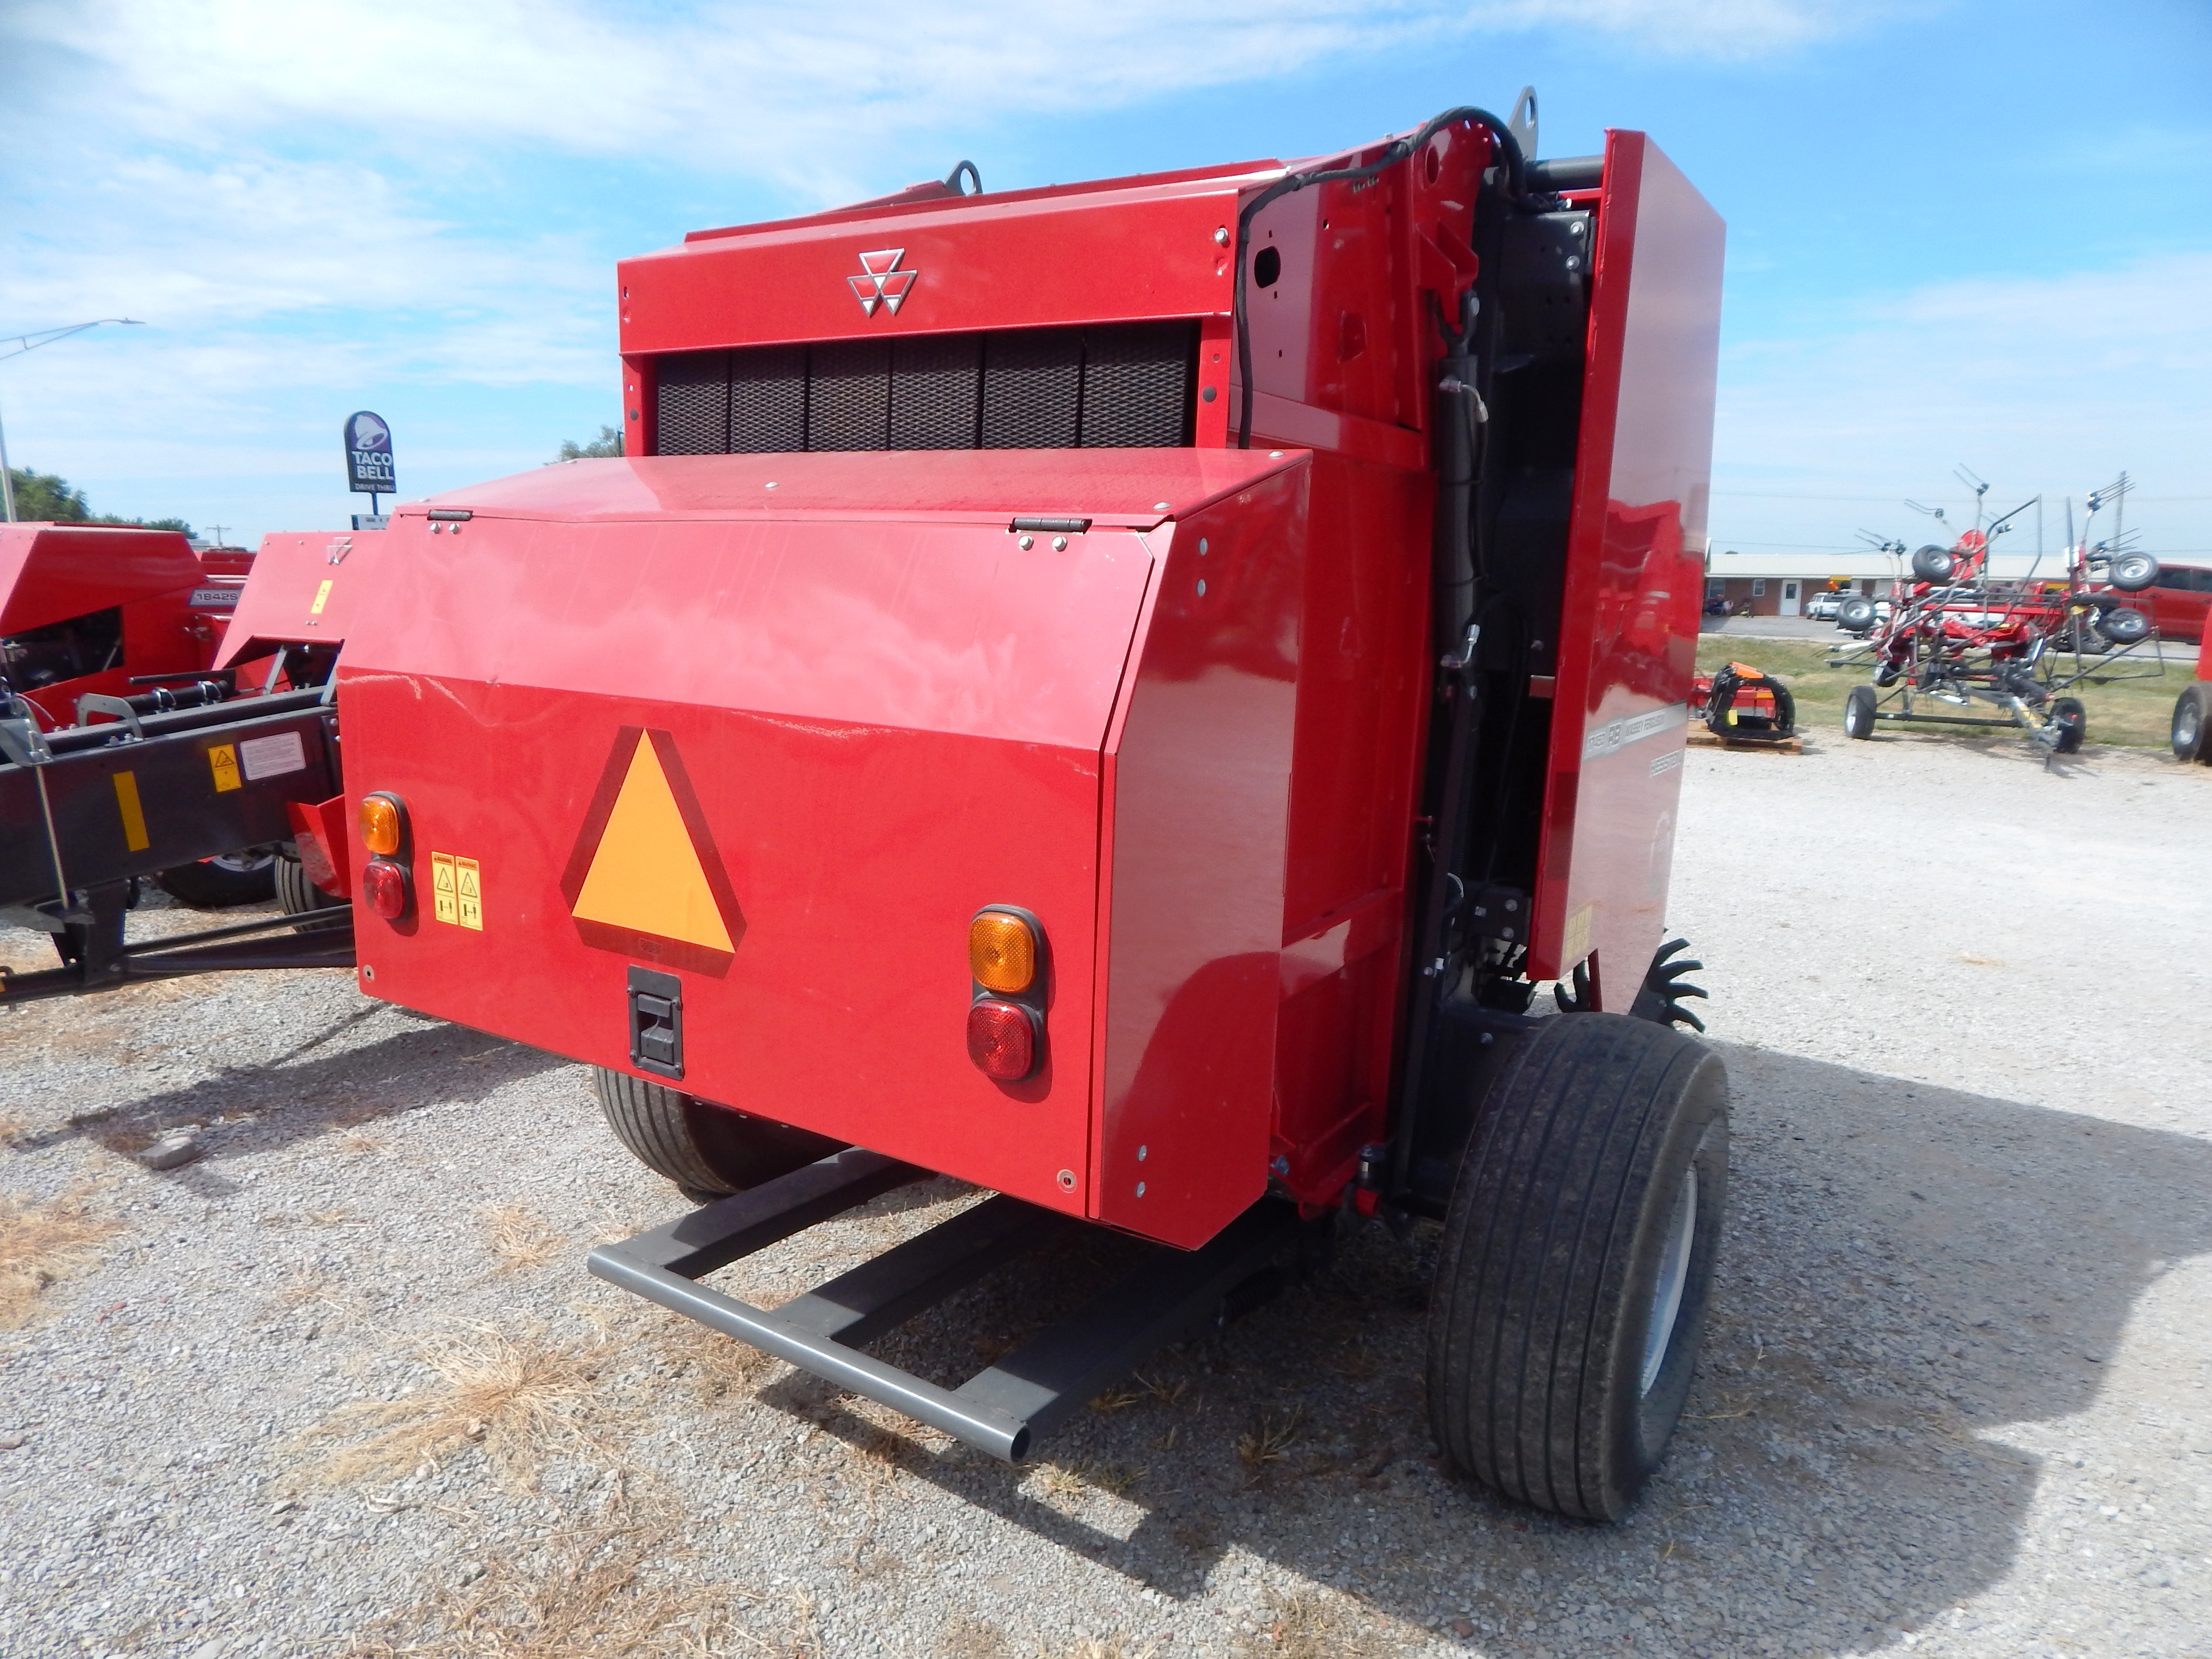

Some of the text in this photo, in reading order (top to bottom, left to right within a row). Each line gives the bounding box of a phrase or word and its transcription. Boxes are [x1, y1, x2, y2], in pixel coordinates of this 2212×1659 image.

[352, 451, 392, 466] TACO
[357, 465, 393, 480] BELL
[1608, 723, 1622, 747] RB
